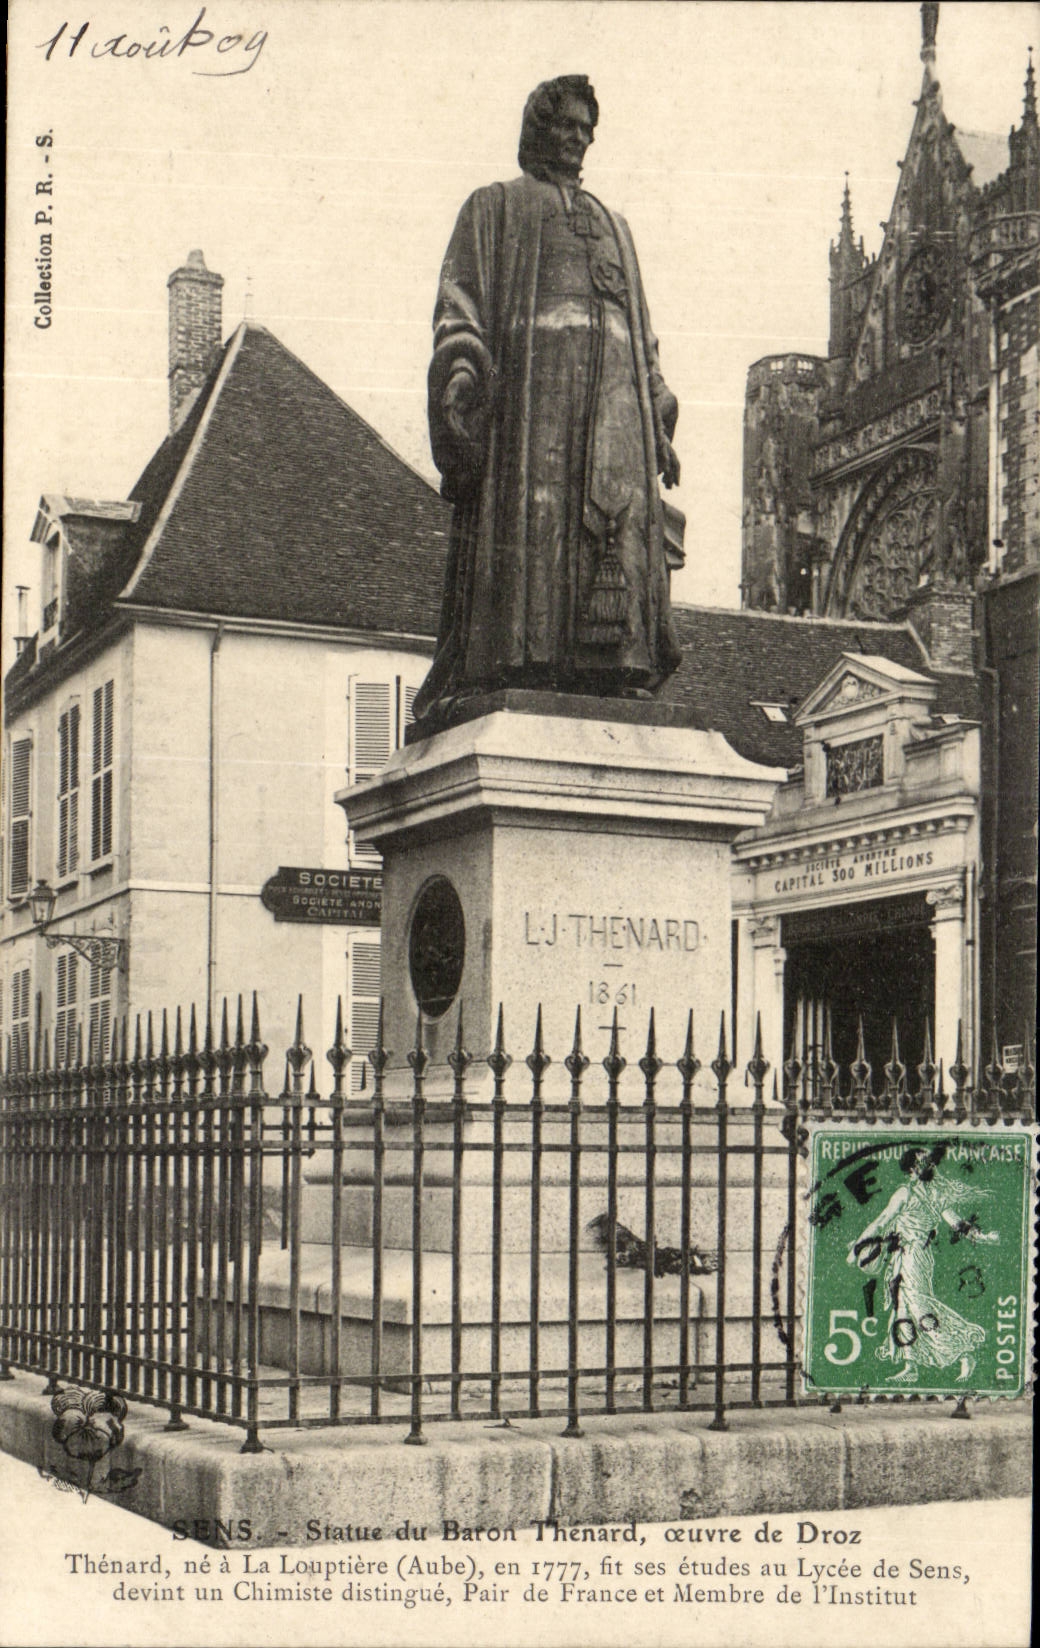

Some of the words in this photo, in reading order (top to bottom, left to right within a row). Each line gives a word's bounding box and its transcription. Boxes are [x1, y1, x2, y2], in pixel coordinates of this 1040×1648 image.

[35, 21, 90, 61] 11
[774, 875, 824, 893] CAPITAL
[864, 851, 934, 877] MILLIONS
[588, 980, 637, 1006] 1861
[996, 1294, 1017, 1380] POSTES
